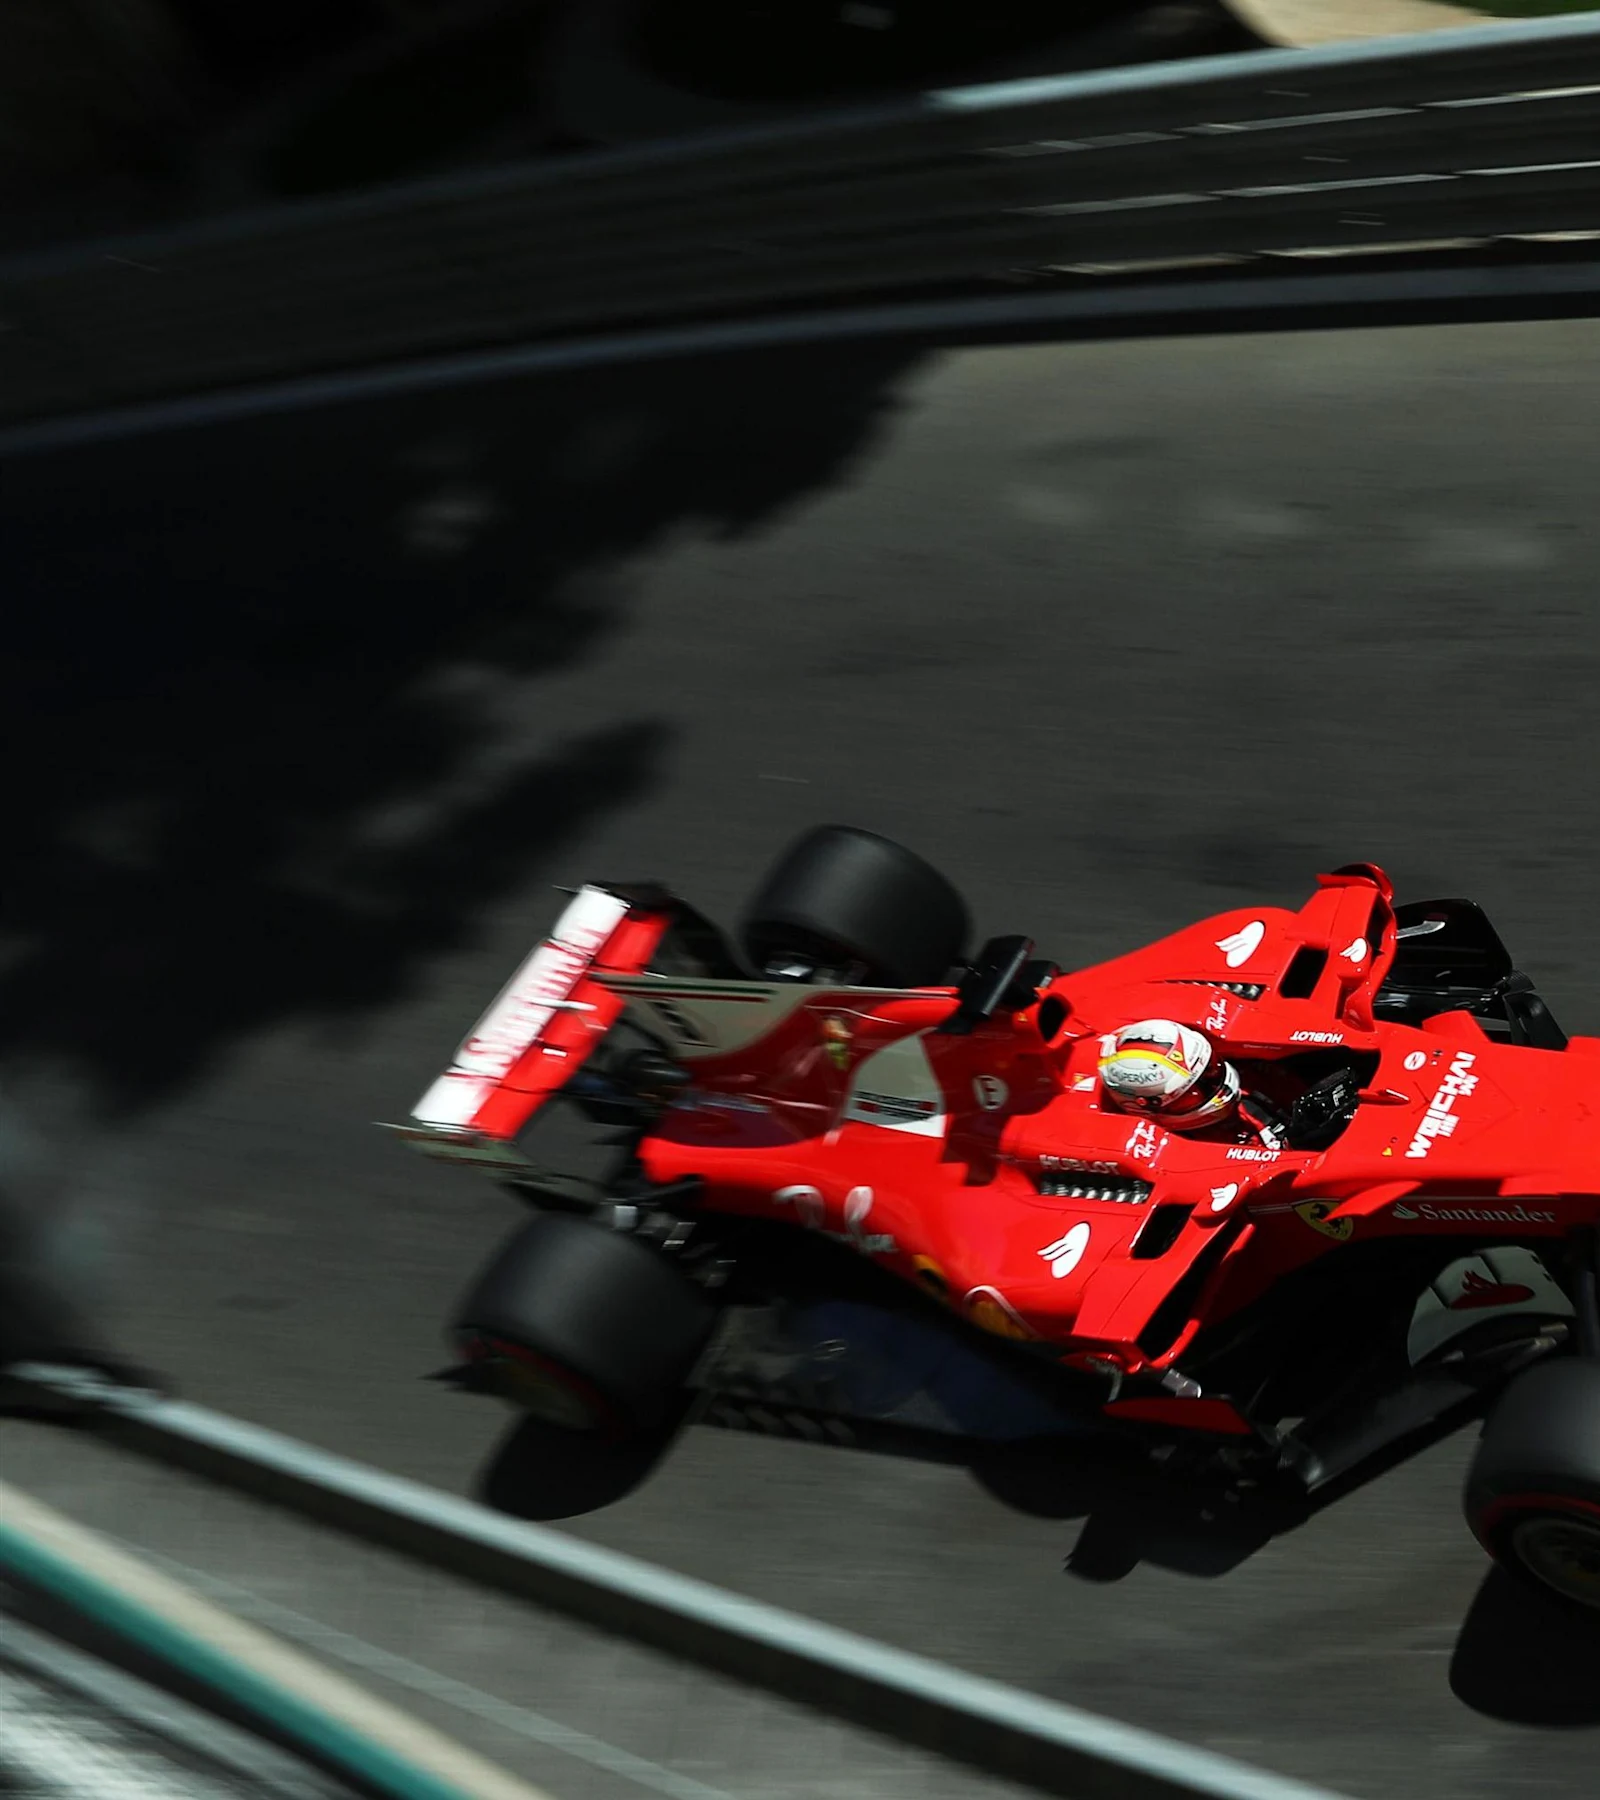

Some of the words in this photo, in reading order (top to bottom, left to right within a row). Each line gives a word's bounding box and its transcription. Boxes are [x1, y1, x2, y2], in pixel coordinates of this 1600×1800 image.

[1290, 1031, 1343, 1044] HUBLOT
[1404, 1051, 1476, 1158] WEICHAI
[1226, 1148, 1280, 1162] HUBLOT
[1418, 1203, 1556, 1223] Santander
